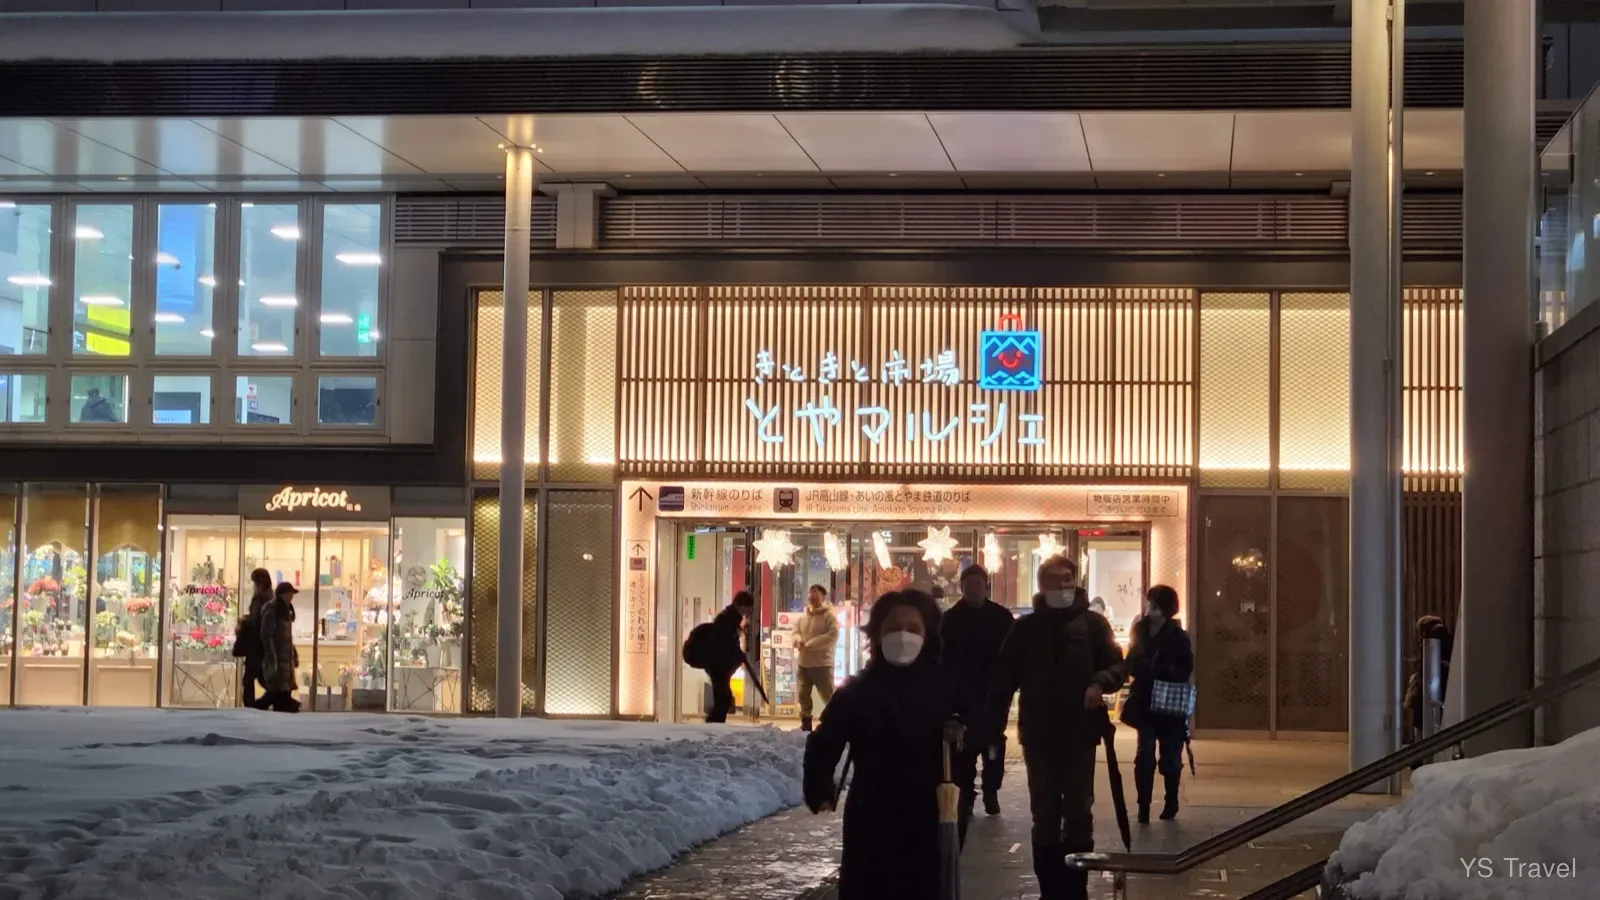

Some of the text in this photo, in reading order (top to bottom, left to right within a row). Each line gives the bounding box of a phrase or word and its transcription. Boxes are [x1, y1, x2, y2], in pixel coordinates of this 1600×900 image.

[755, 350, 960, 386] きときと市場
[745, 396, 1046, 448] とやマルシェ
[265, 486, 348, 511] Apricot
[690, 488, 763, 501] 新幹線のりば
[1093, 494, 1170, 504] 物販店営業時間中
